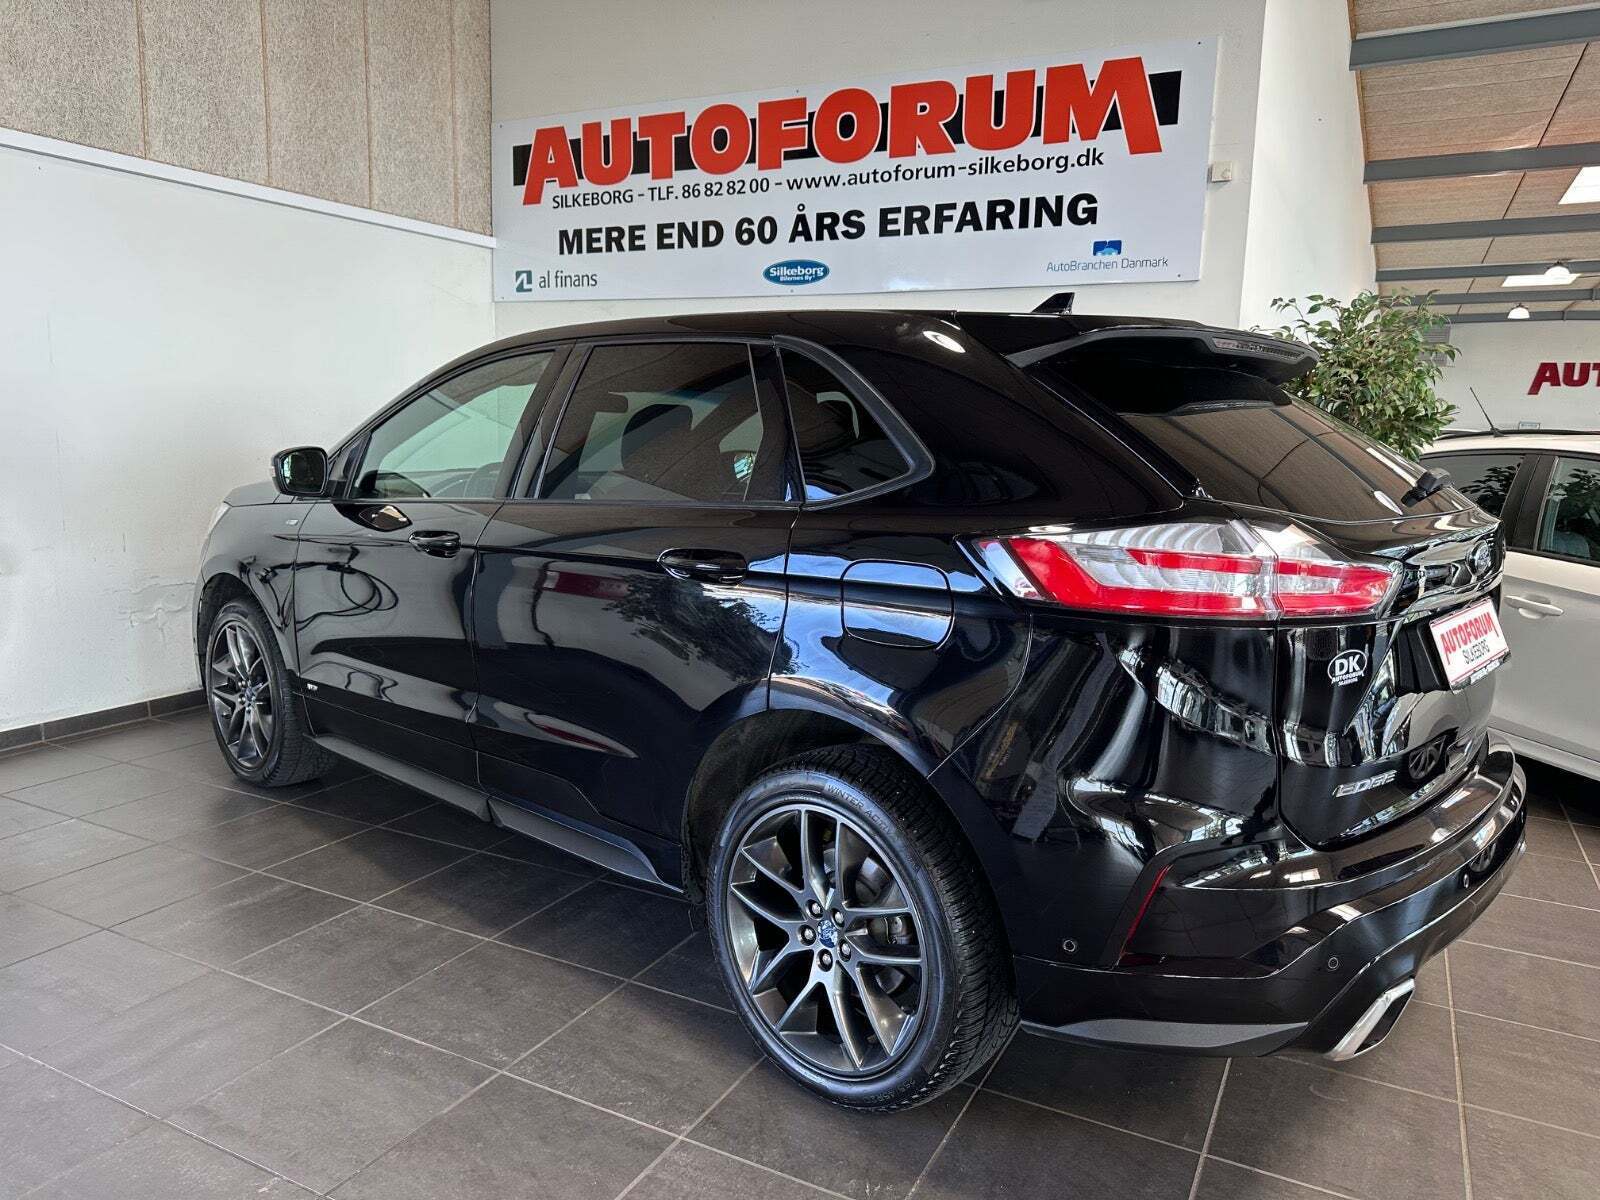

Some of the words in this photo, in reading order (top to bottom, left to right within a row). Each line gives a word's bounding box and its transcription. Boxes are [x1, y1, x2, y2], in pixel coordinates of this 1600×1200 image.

[522, 56, 1163, 206] AUTOFORUM
[552, 189, 634, 209] SILKEBORG
[648, 185, 679, 201] TLF.
[681, 184, 701, 199] 86
[704, 181, 723, 197] 82
[726, 179, 746, 196] 82
[749, 177, 770, 193] 00
[786, 148, 1105, 191] www.autoforum-silkeborg.dk
[558, 225, 646, 255] MERE
[656, 219, 724, 251] END
[734, 216, 778, 246] 60
[788, 203, 866, 244] ÅRS
[878, 192, 1099, 238] ERFARING
[769, 265, 825, 277] Silkeborg
[1046, 260, 1118, 272] AutoBranchen
[1121, 257, 1169, 269] Danmark
[539, 270, 551, 289] al
[555, 270, 598, 289] finans
[1440, 611, 1500, 665] AUTOFORUM
[1335, 654, 1361, 676] DK
[827, 784, 864, 809] WINTER
[1332, 769, 1398, 798] EDGE
